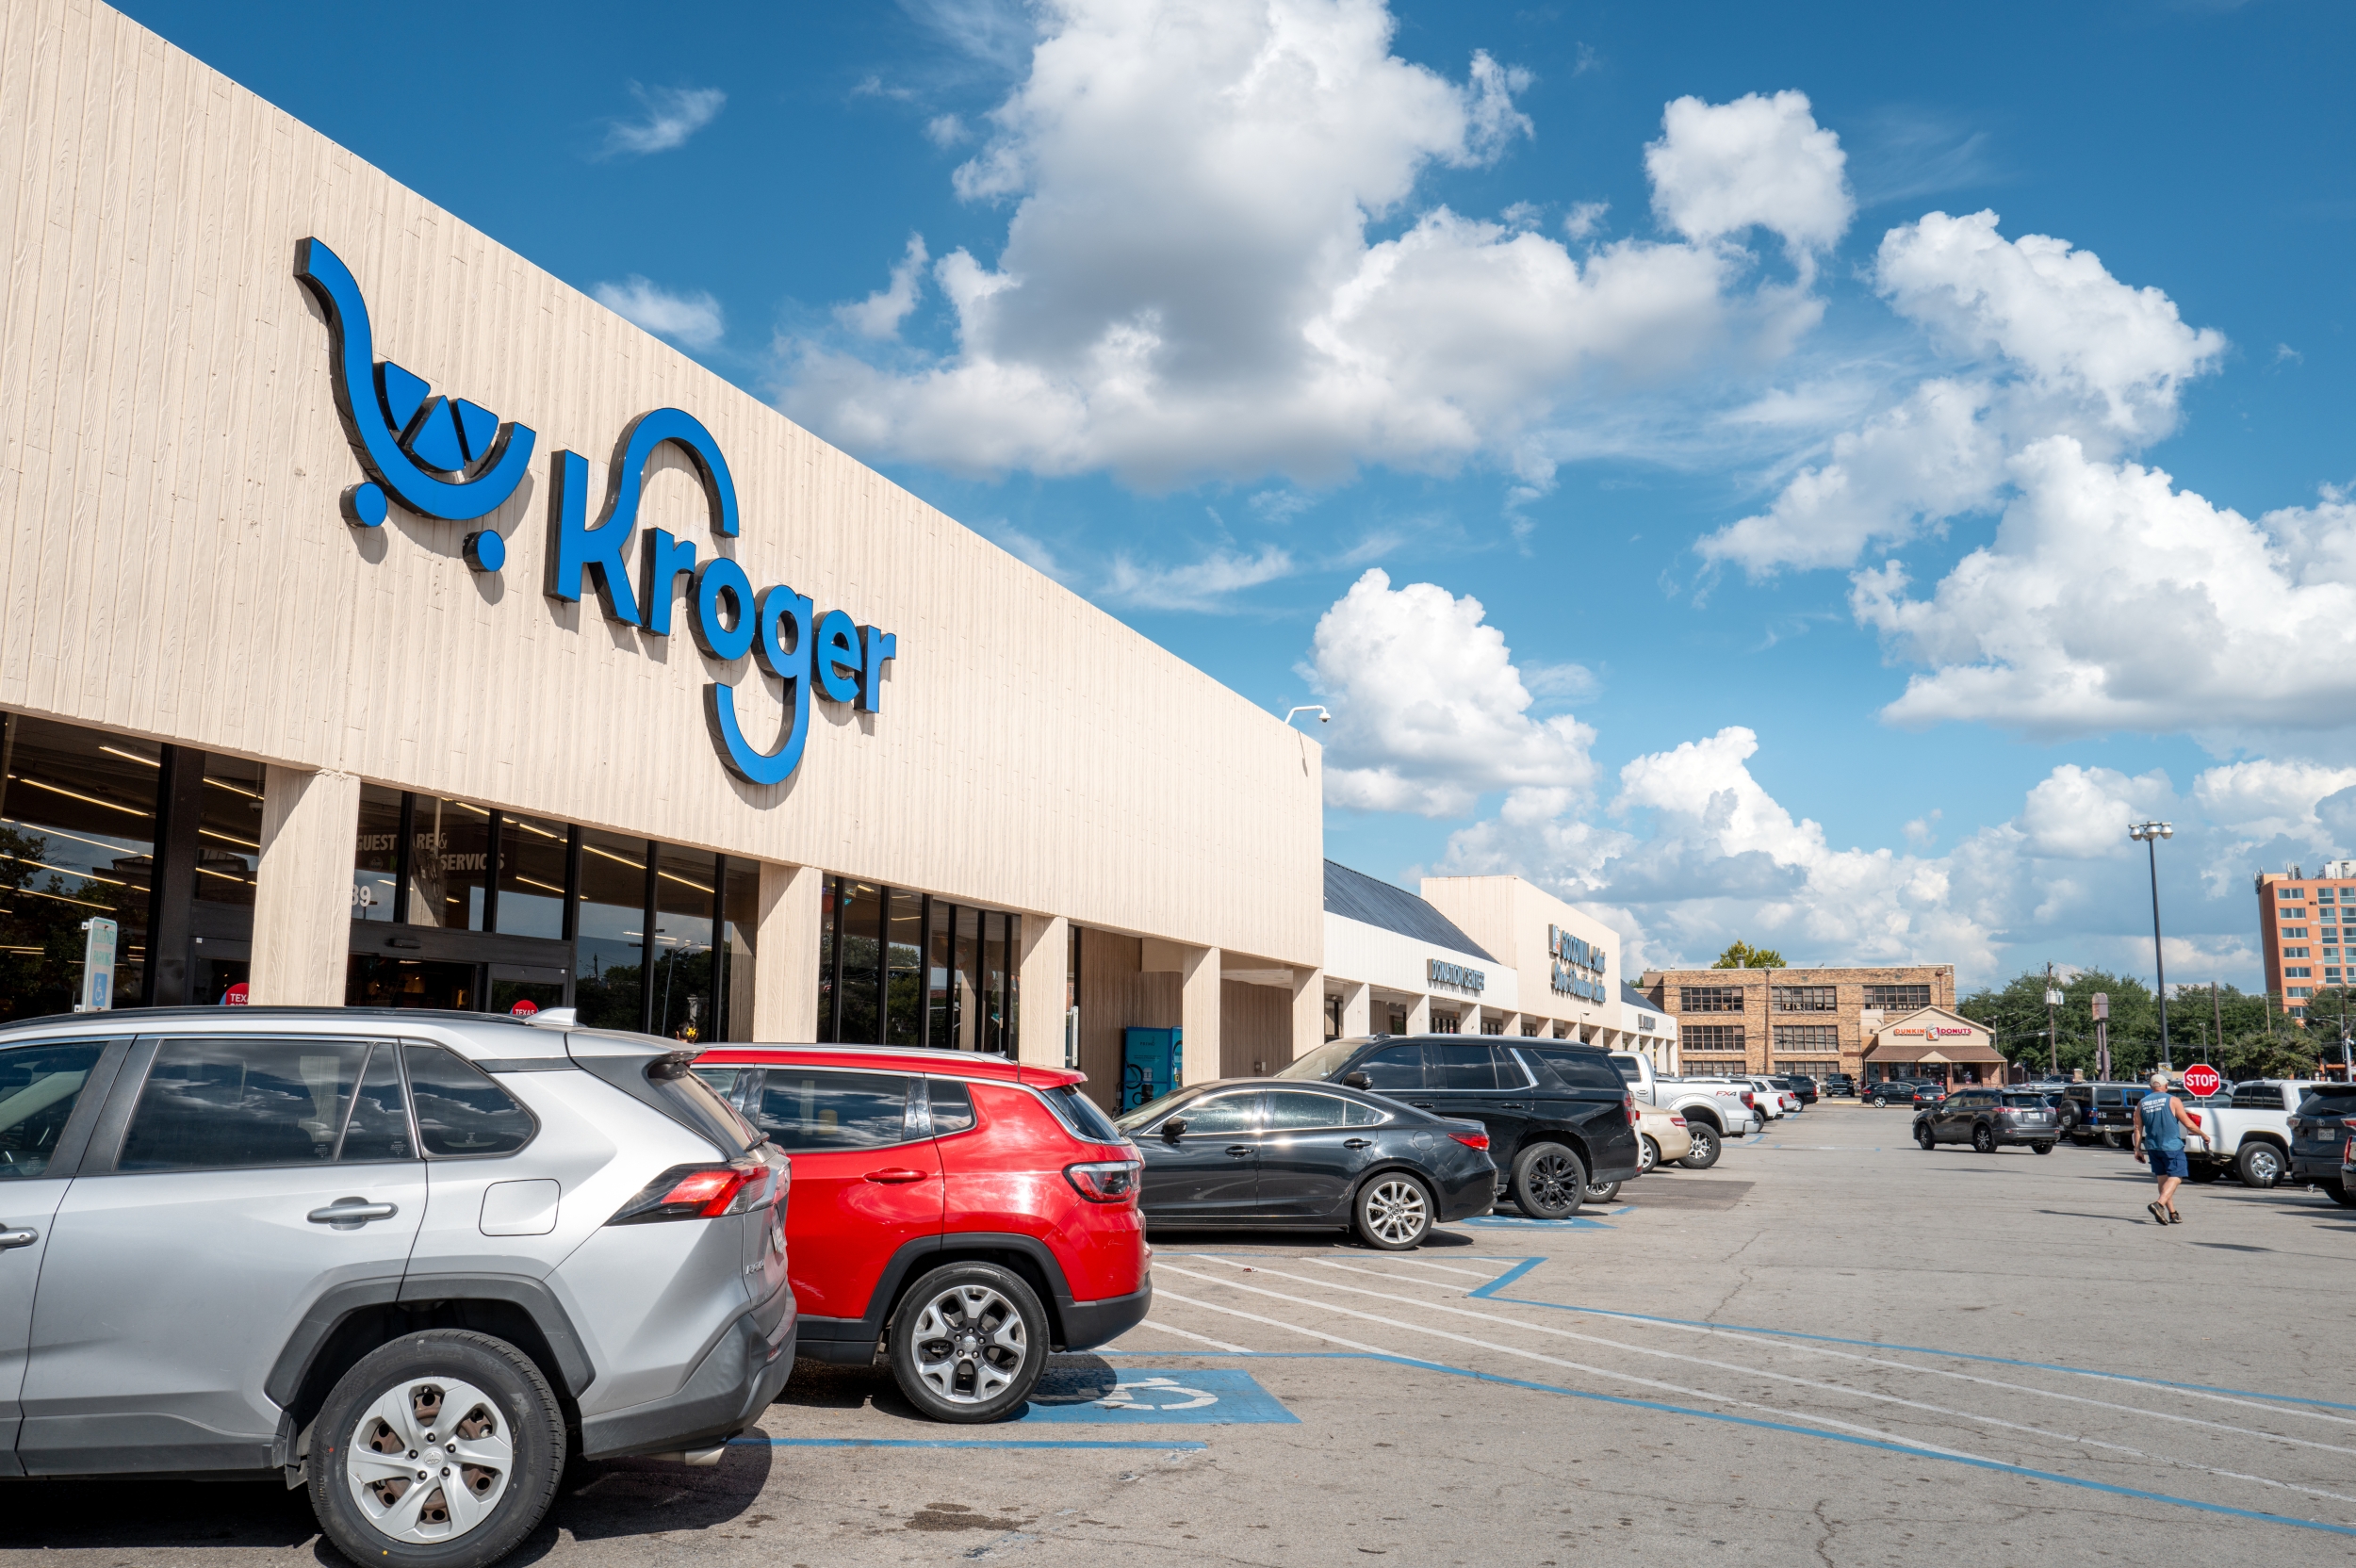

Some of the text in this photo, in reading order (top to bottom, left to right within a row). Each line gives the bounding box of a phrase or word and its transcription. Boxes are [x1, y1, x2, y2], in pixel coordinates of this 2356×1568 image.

[545, 407, 896, 785] Kroger
[356, 834, 397, 851] GUEST
[441, 853, 504, 871] SERVICS
[1560, 929, 1593, 970] GOODWILL
[1430, 958, 1485, 990] DONATION CENTER
[230, 993, 249, 1003] TEX
[2186, 1074, 2217, 1086] STOP
